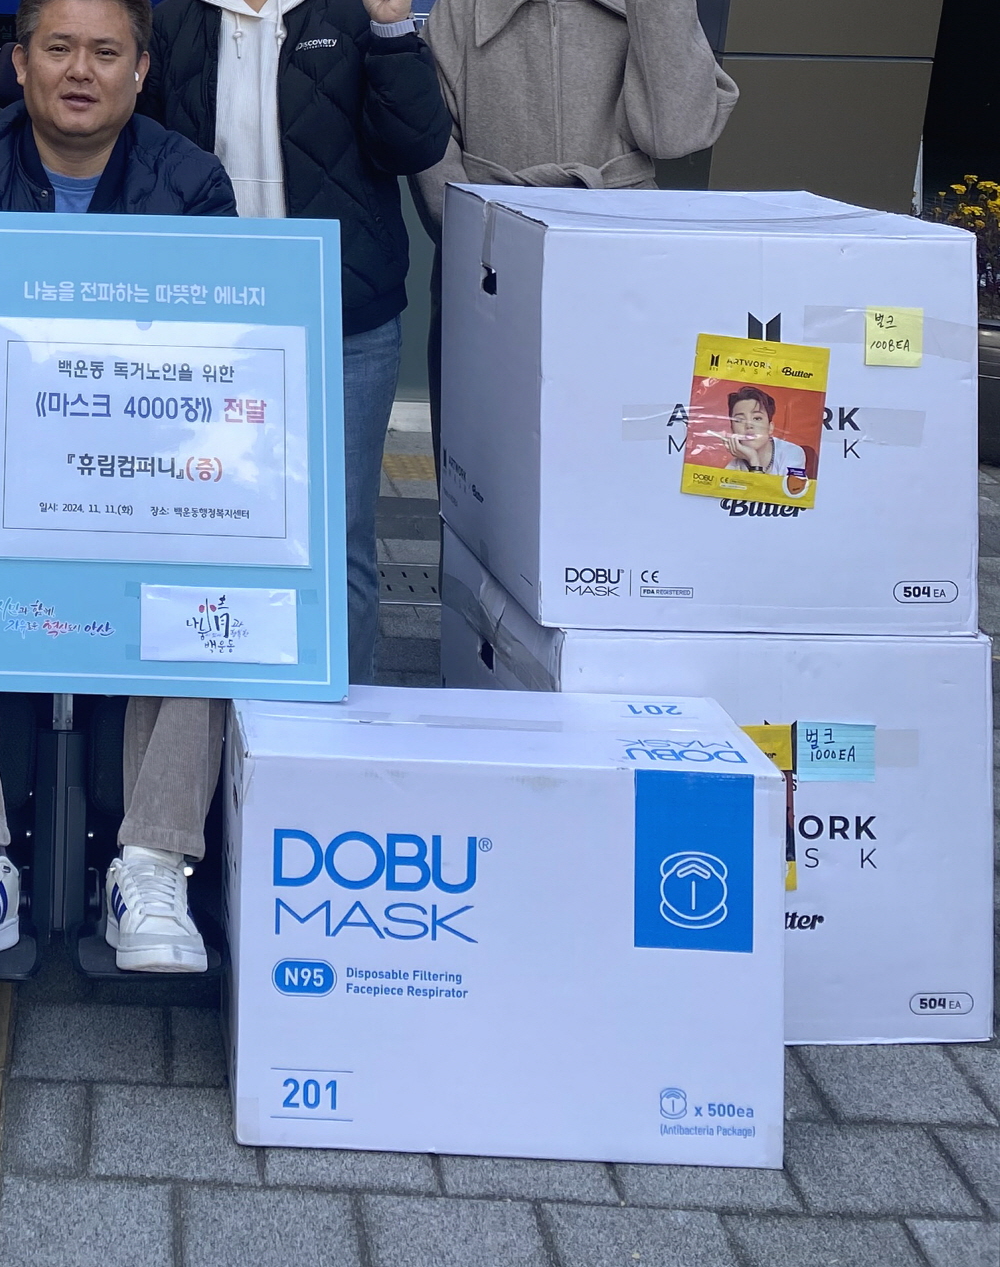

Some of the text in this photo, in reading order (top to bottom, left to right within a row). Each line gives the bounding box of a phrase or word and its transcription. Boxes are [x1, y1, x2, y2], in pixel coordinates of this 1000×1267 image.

[23, 280, 266, 307] 나눔을 전파하는 따뜻한 에너지
[58, 359, 235, 384] 백운동 독거노인을 위한
[781, 366, 814, 379] Butter
[223, 397, 267, 424] 전달
[39, 502, 58, 513] 일시:
[150, 506, 170, 516] 장소:
[173, 507, 250, 520] 백운동행정복지센터
[565, 567, 660, 584] DOBU CE
[565, 584, 620, 597] MASK
[903, 586, 947, 598] 504 EA
[4, 618, 115, 640] 자유로운 혁신도시 안산
[627, 704, 683, 716] 201
[275, 898, 478, 944] MASK
[284, 967, 324, 988] N95
[346, 967, 462, 984] Disposable Filtering
[346, 983, 468, 1000] Facepiece Respirator
[919, 997, 962, 1010] 504 EA
[282, 1078, 337, 1110] 201
[694, 1102, 754, 1118] x 500ea
[660, 1124, 756, 1138] (Antibacteria Package)
